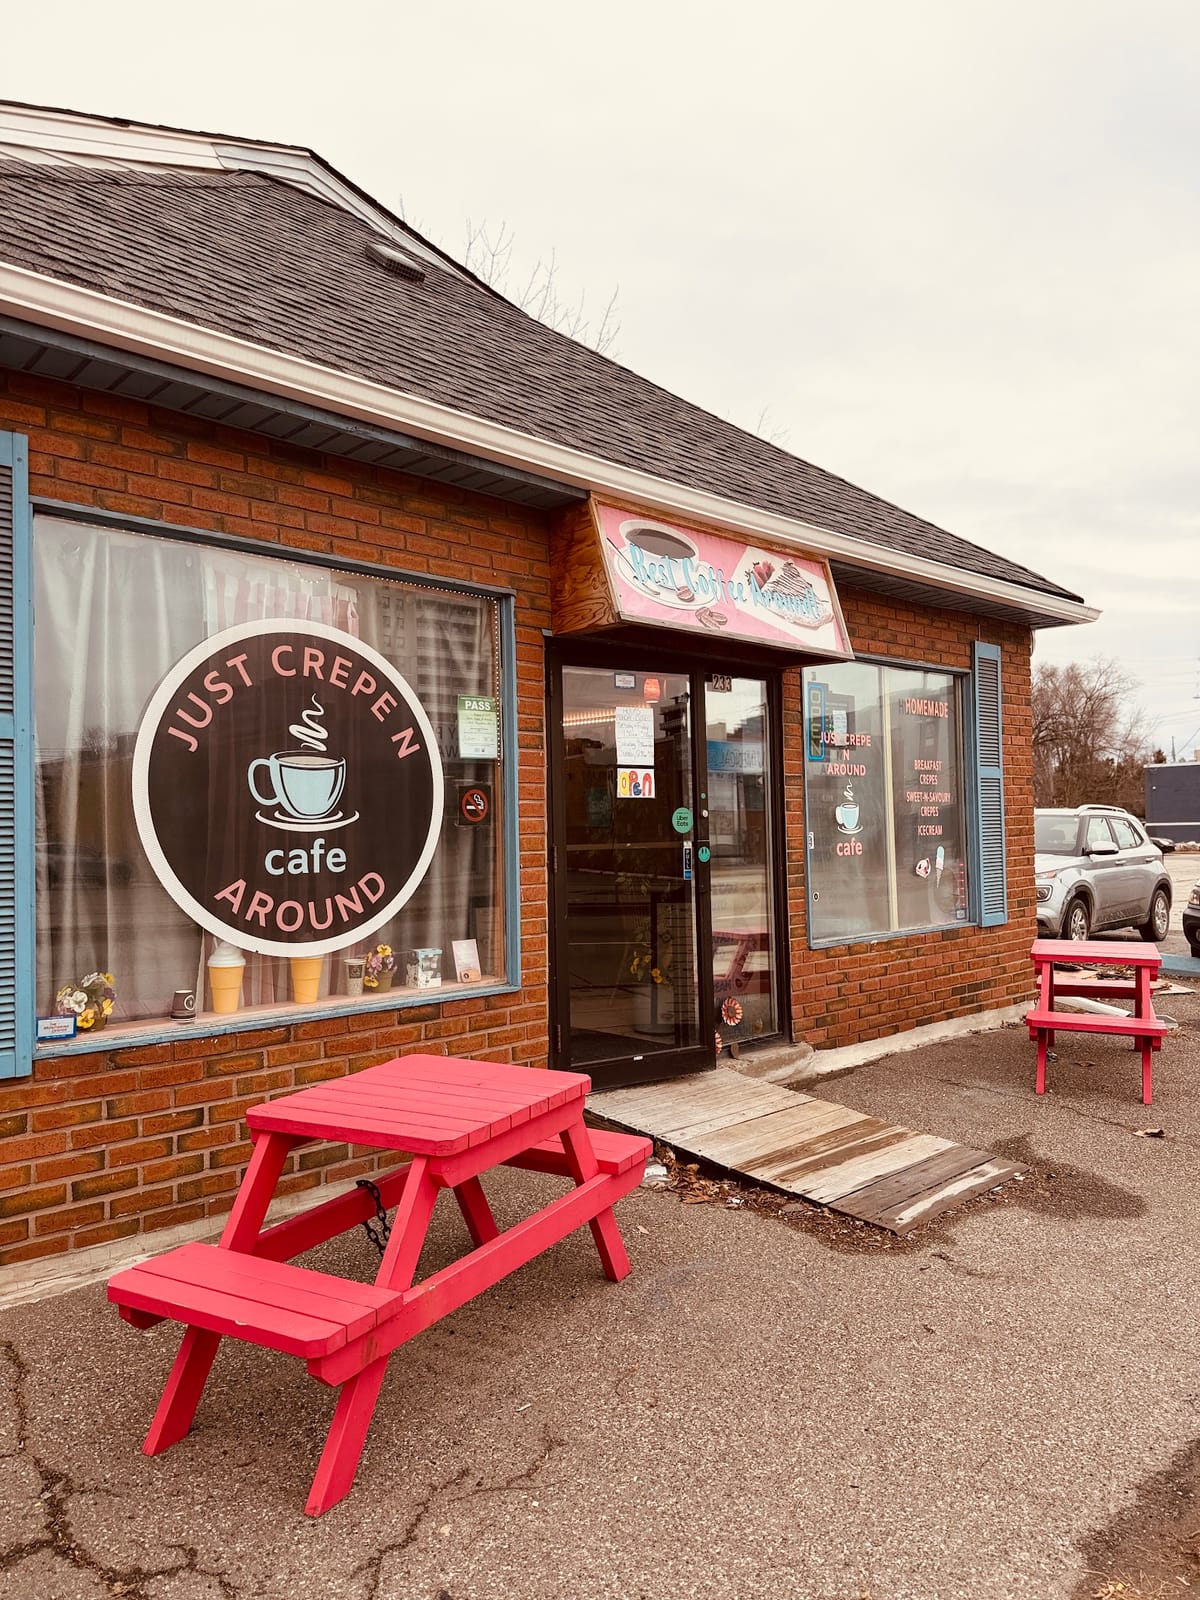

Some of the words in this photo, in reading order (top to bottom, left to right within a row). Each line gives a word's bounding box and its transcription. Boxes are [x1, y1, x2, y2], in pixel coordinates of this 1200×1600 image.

[629, 543, 678, 589] Best
[682, 556, 747, 605] Coffee
[712, 675, 732, 692] 233
[168, 652, 252, 753] JUST
[271, 644, 399, 722] CREPE
[391, 725, 421, 760] N
[465, 700, 491, 711] PASS
[905, 698, 949, 718] HOMEMADE
[844, 733, 871, 747] CREPE
[843, 749, 850, 761] N
[827, 763, 866, 776] AROUND
[914, 759, 942, 771] BREAKFAST
[919, 774, 938, 785] CREPES
[920, 806, 939, 817] CREPES
[836, 838, 863, 856] cafe
[264, 838, 348, 876] cafe
[214, 871, 387, 933] AROUND
